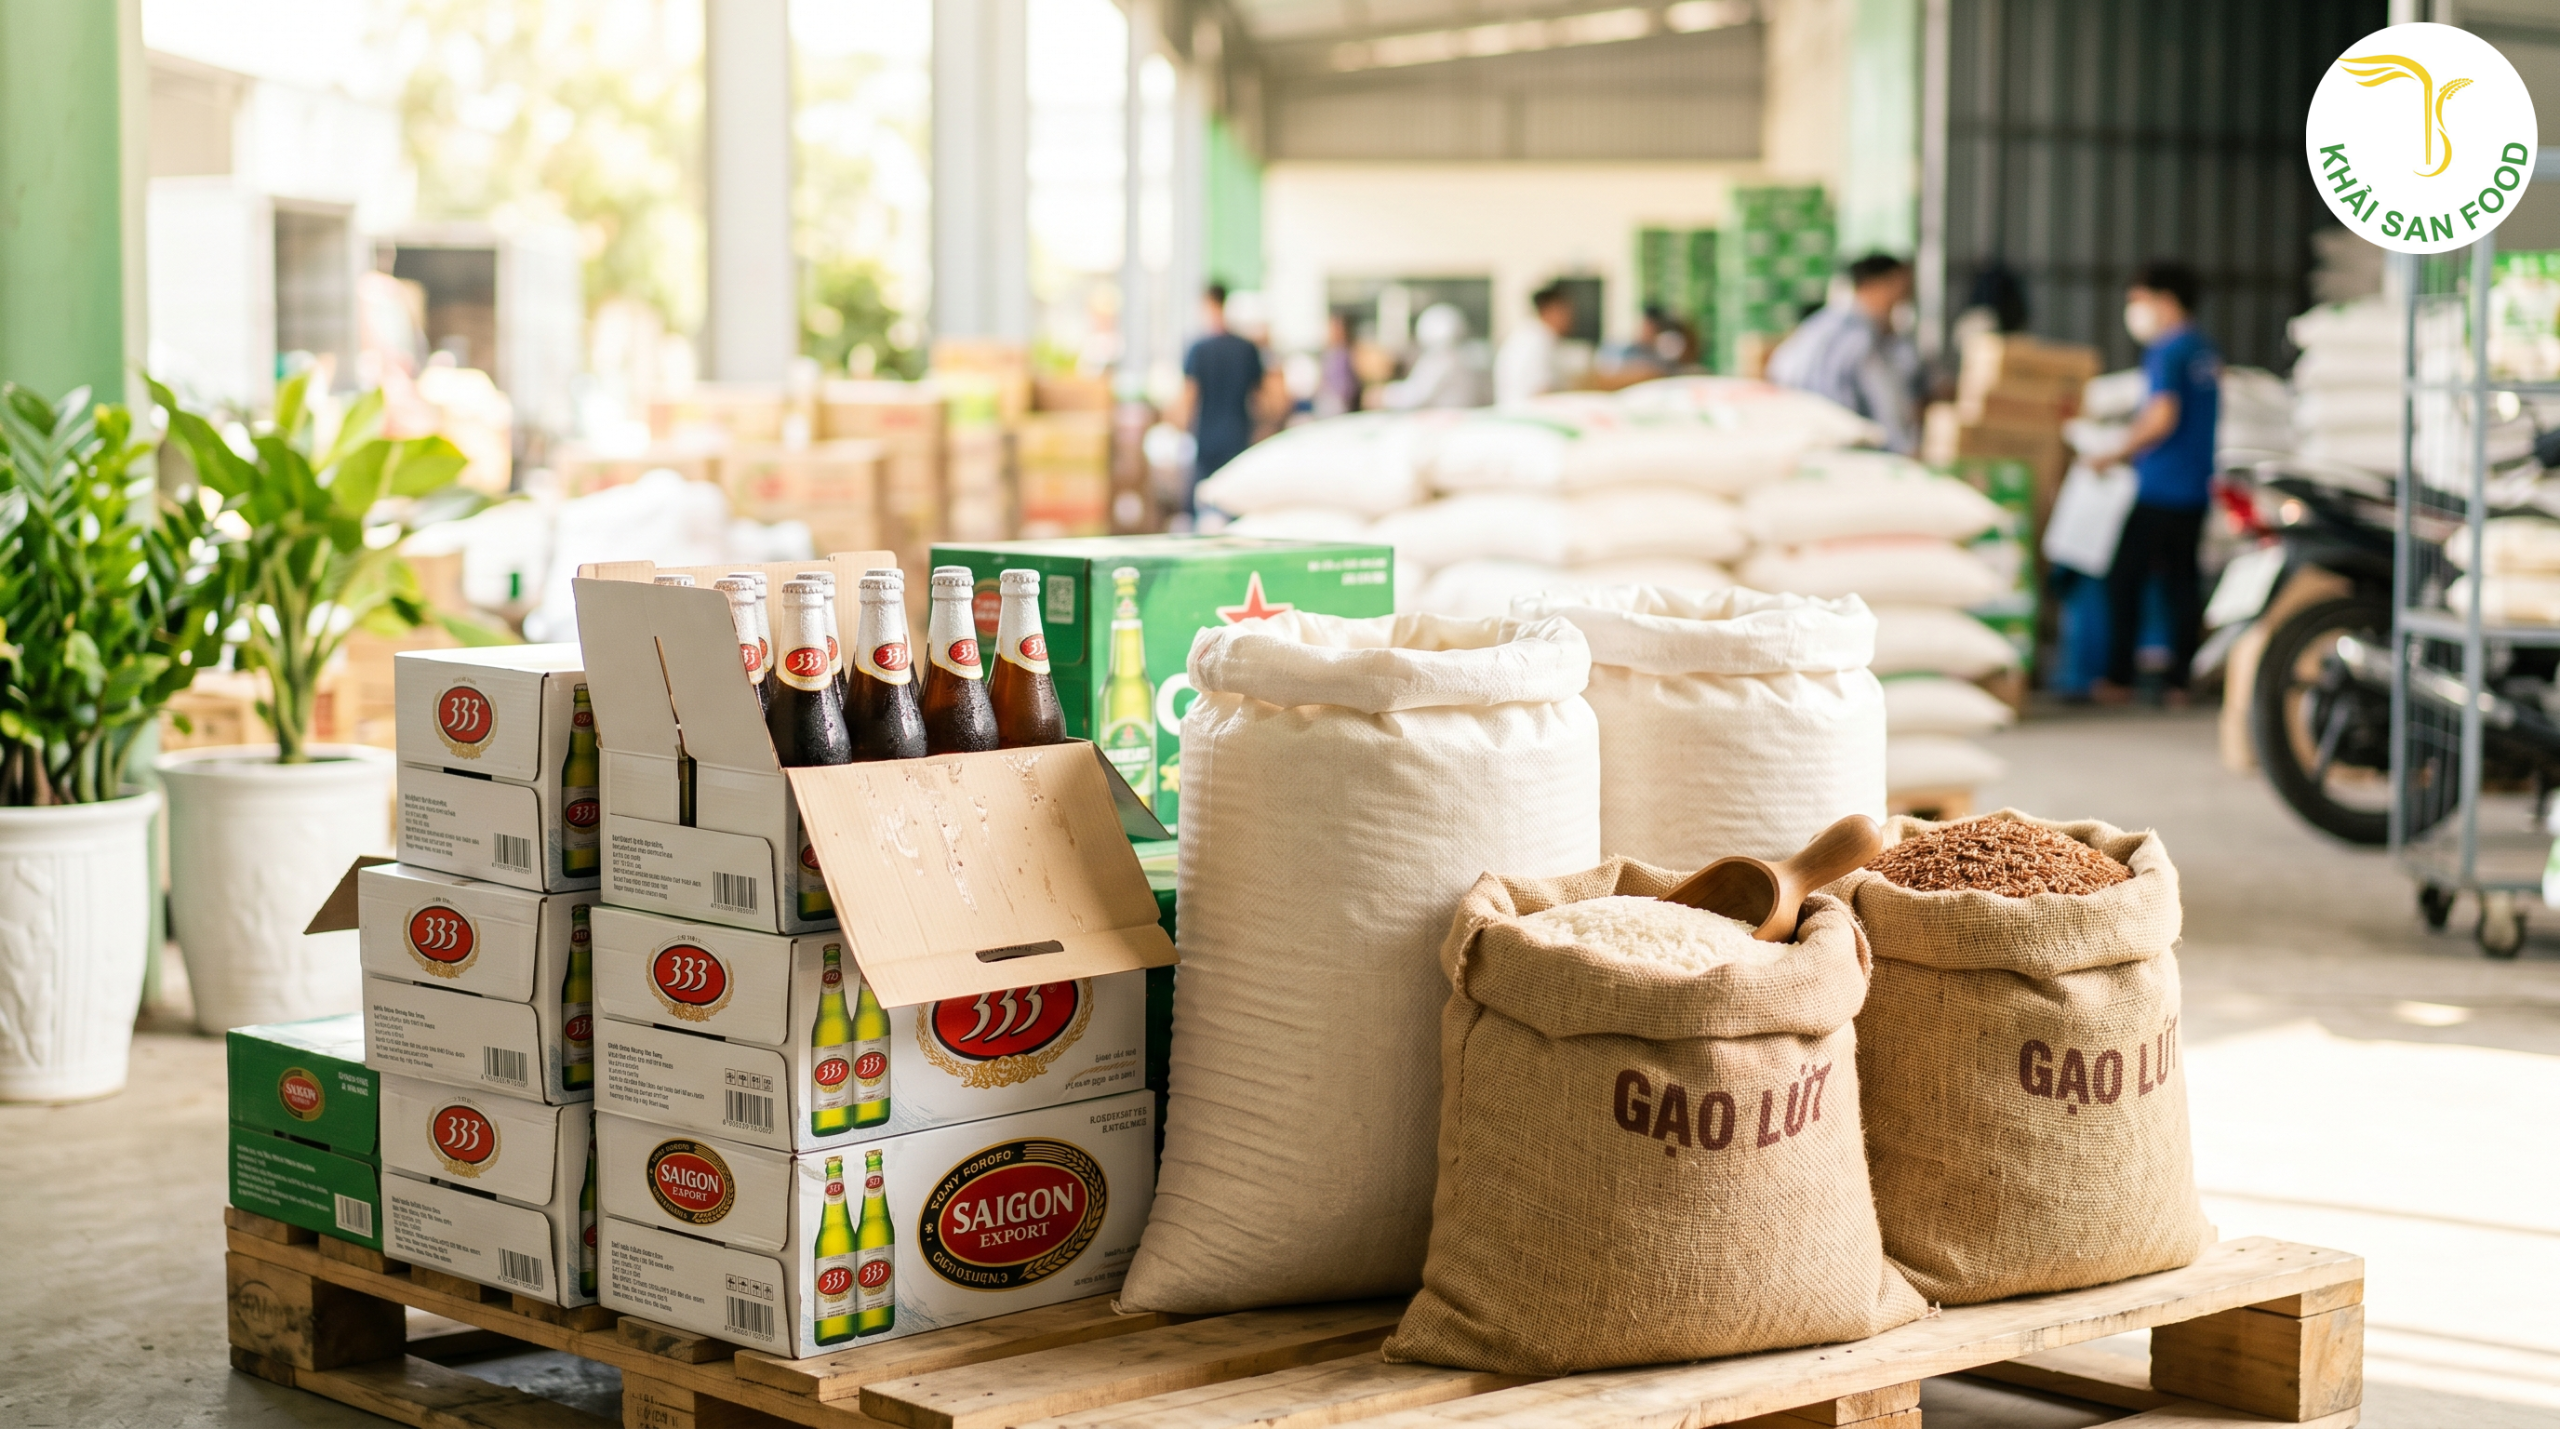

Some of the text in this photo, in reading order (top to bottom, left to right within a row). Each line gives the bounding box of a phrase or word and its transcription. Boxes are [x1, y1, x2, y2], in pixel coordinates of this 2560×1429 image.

[446, 697, 480, 732] 333
[420, 916, 459, 951] 333
[665, 955, 708, 991] 333
[2019, 1040, 2123, 1115] GẠO
[1613, 1069, 1736, 1157] GẠO
[443, 1116, 480, 1152] 333
[661, 1164, 719, 1194] SAIGON
[952, 1183, 1075, 1235] SAIGON
[979, 1222, 1050, 1248] EXPORT
